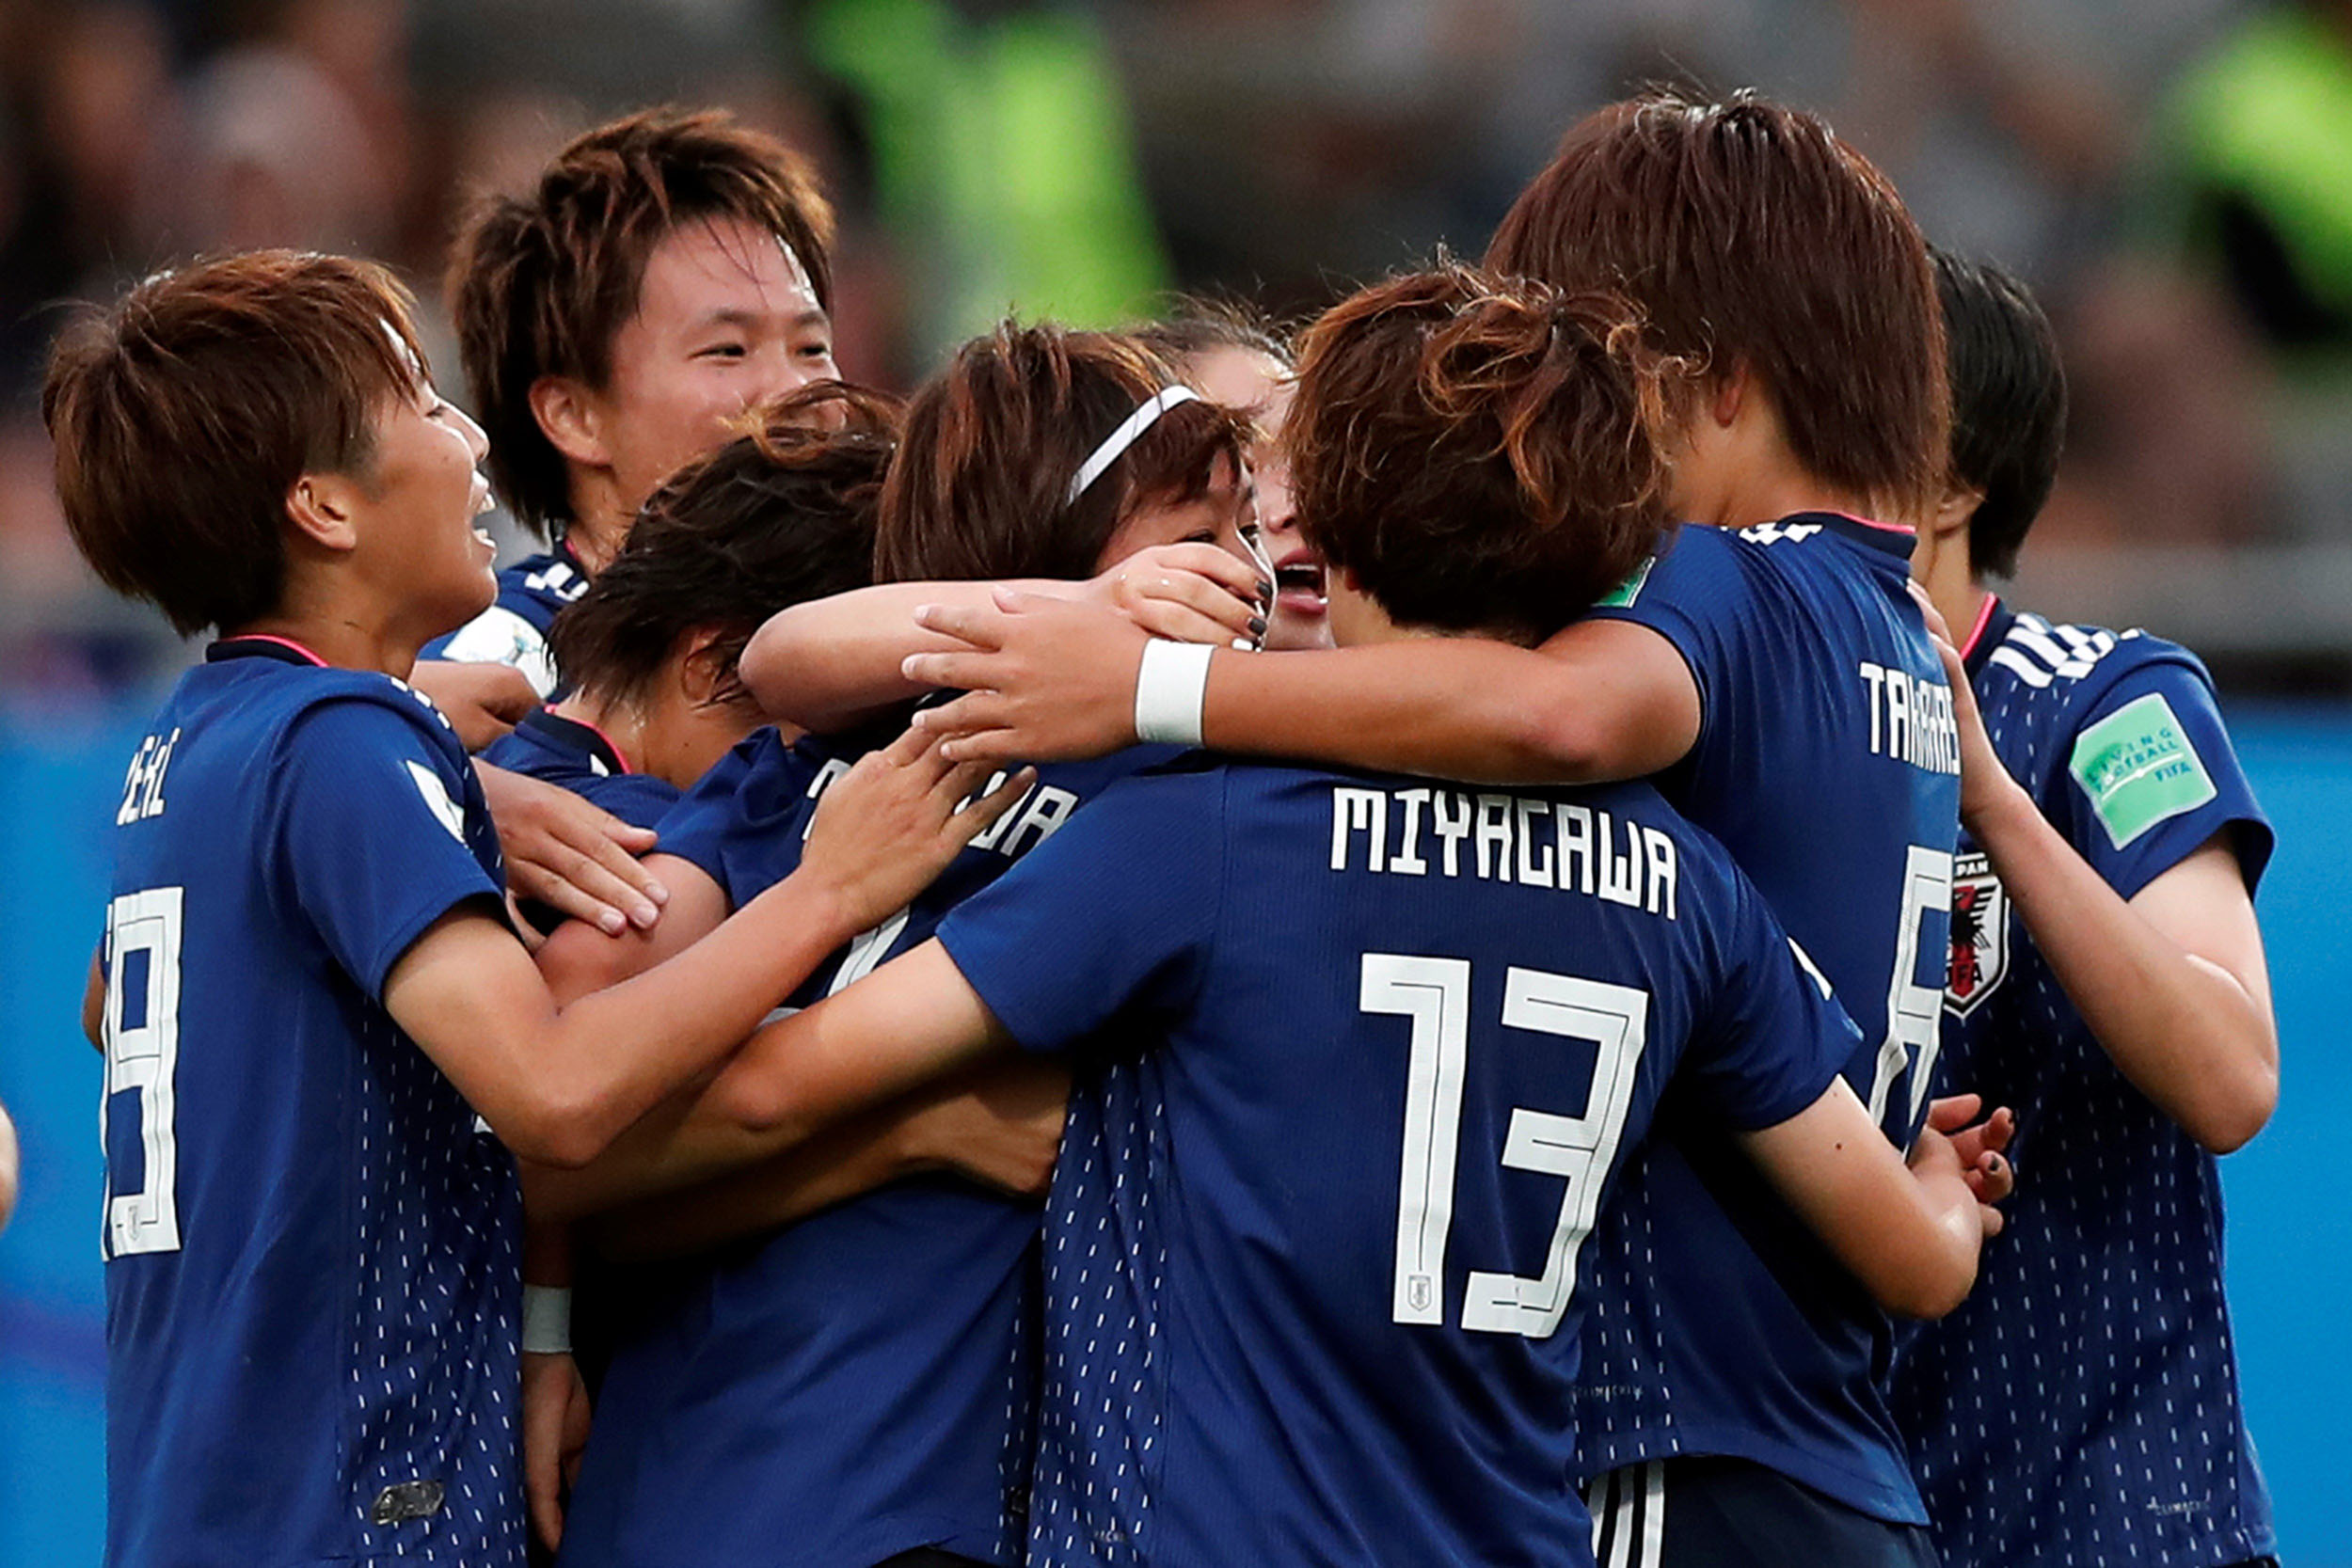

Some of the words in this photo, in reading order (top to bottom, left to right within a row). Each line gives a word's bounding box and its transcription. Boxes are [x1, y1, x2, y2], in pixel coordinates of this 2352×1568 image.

[2154, 761, 2192, 783] FIFA
[1330, 787, 1678, 920] MIYAGAWA
[1359, 953, 1649, 1338] 13
